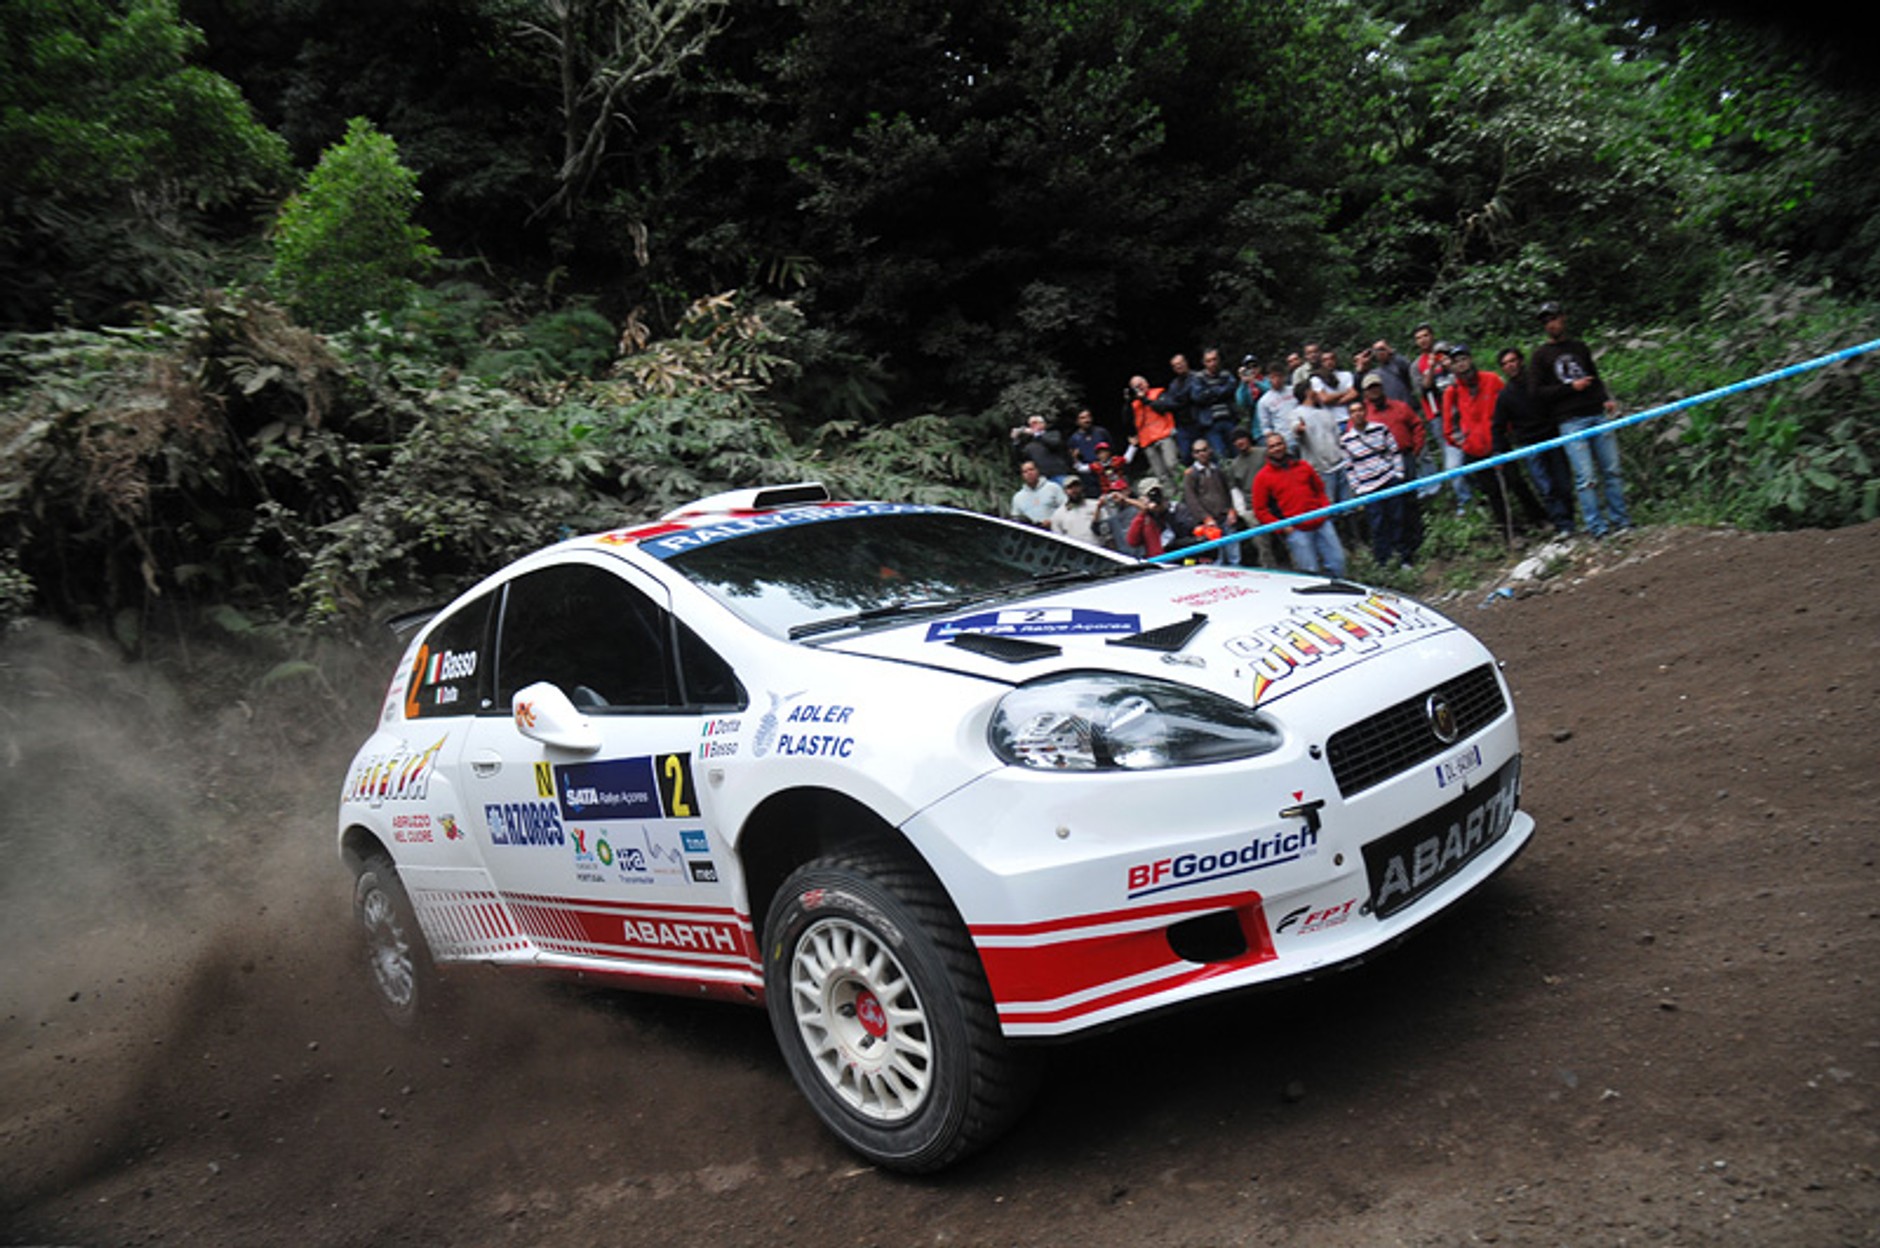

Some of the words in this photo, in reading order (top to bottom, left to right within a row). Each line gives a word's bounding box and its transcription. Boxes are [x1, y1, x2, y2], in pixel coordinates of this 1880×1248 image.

[1024, 611, 1045, 622] 2
[405, 643, 430, 719] 2
[786, 705, 855, 724] ADLER
[776, 733, 855, 758] PLASTIC
[535, 763, 554, 796] N
[664, 754, 691, 817] 2
[566, 788, 599, 806] SATA
[1127, 825, 1317, 890] BFGoodrich
[1377, 777, 1517, 907] ABARTH
[1304, 898, 1358, 926] FPT
[623, 919, 737, 951] ABARTH
